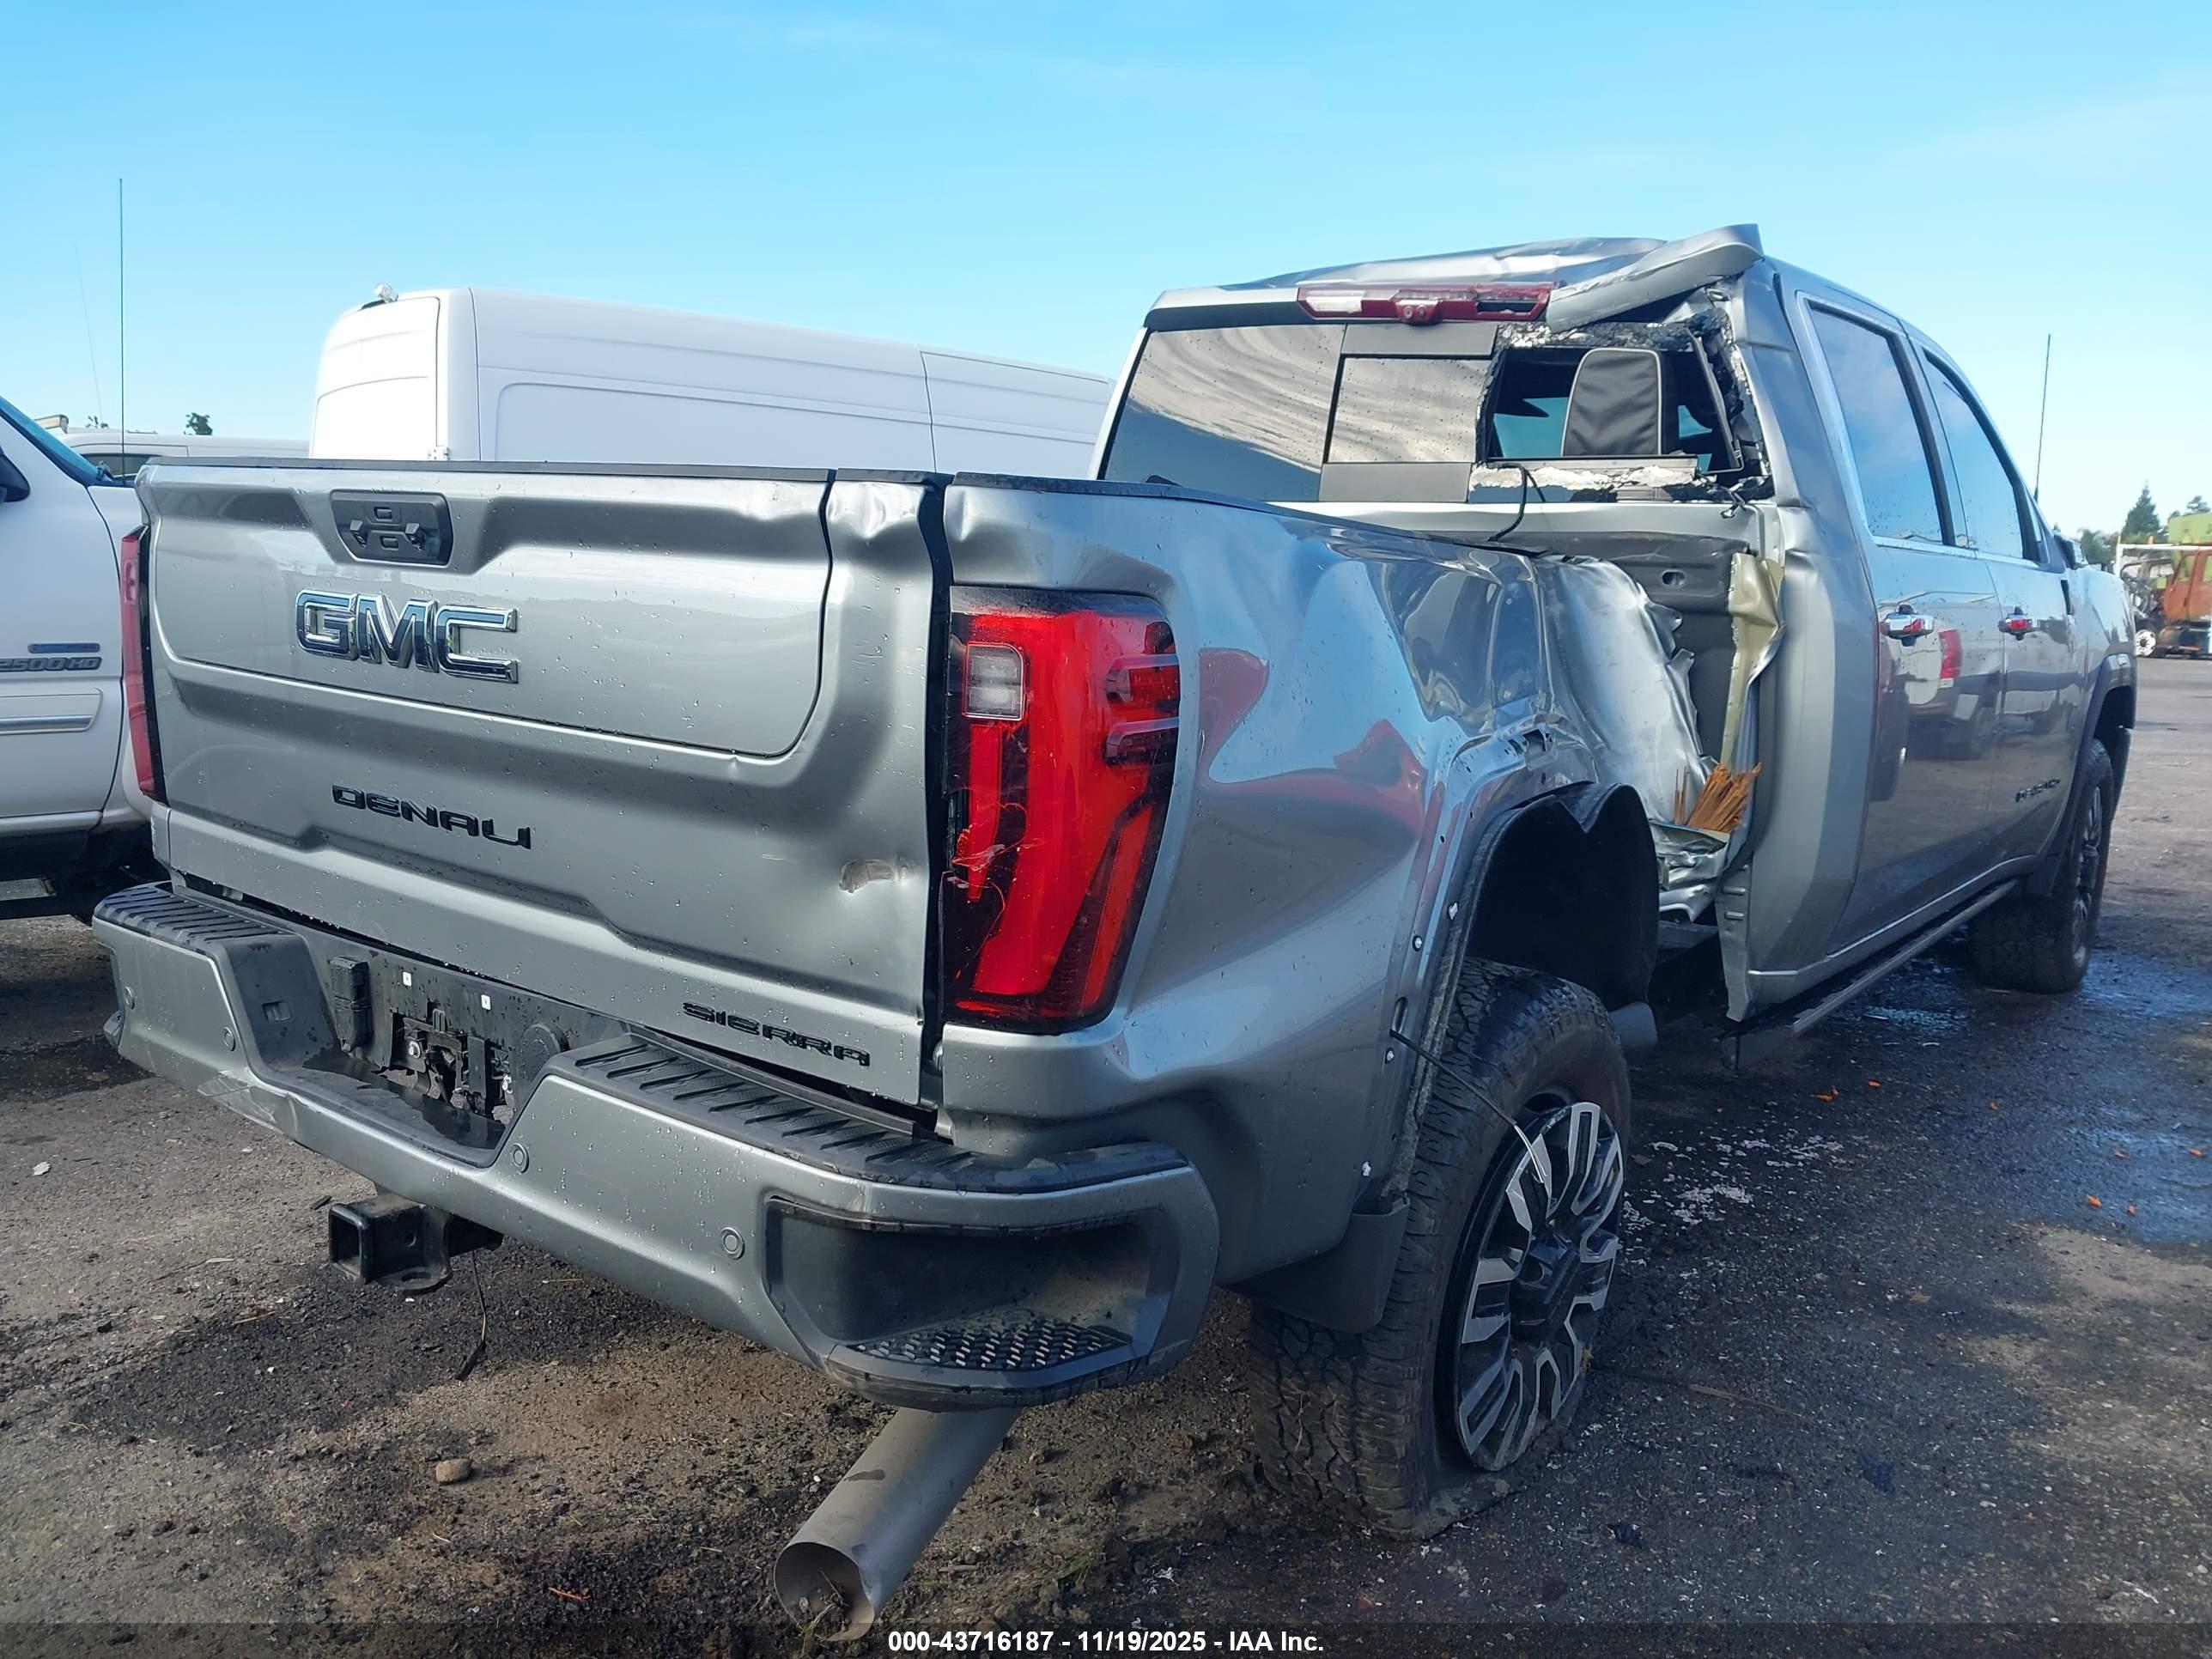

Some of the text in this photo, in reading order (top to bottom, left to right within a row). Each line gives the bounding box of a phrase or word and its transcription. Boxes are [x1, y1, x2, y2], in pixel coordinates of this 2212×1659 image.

[296, 589, 519, 684] GMC
[332, 784, 532, 849] DENALI
[683, 1002, 871, 1066] SIERRA
